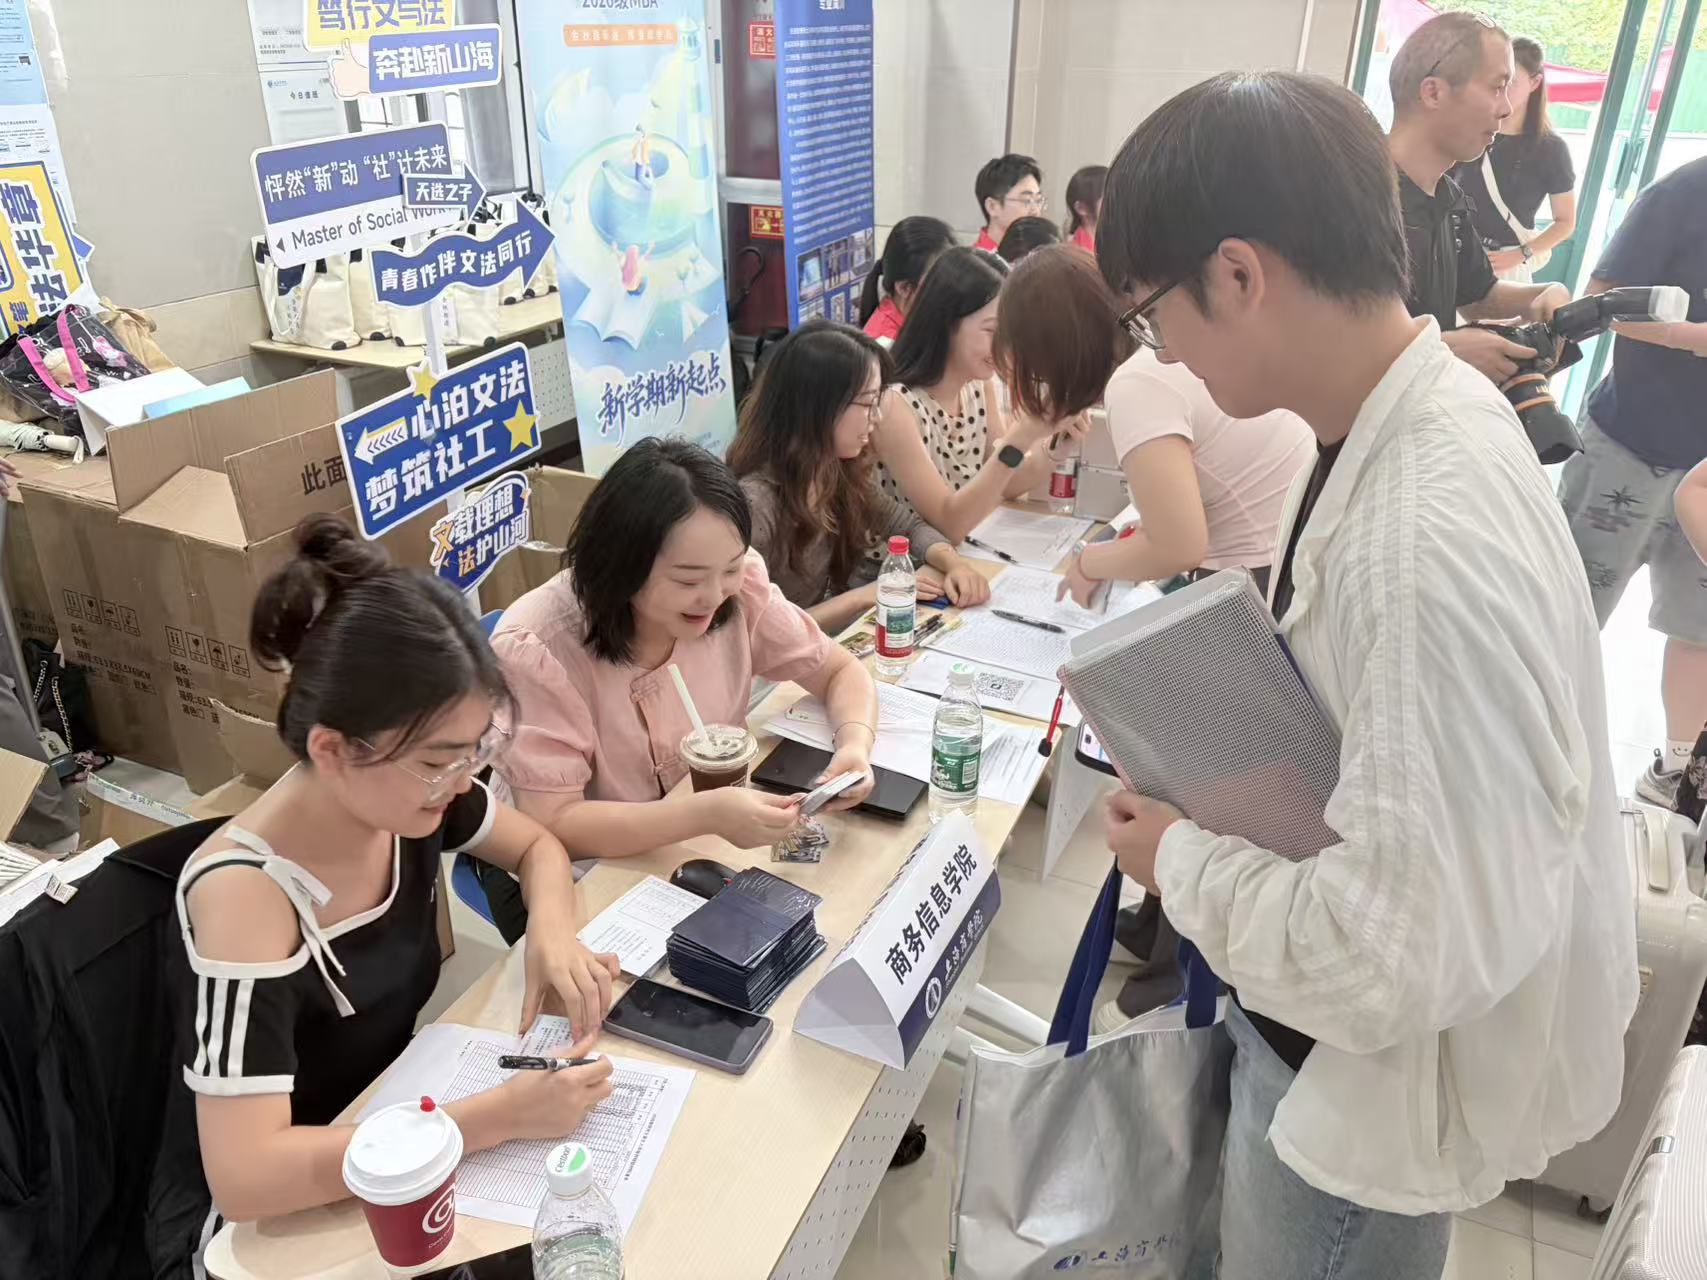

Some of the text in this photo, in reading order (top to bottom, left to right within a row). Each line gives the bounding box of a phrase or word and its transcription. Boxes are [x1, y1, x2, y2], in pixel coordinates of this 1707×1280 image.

[373, 41, 495, 80] 奔赴新山海
[416, 182, 473, 202] 天选之子
[292, 223, 343, 249] Master
[349, 215, 363, 236] of
[366, 206, 408, 231] Social
[381, 230, 533, 291] 青春作伴文法同行
[411, 359, 526, 440] 心泊文法
[597, 352, 727, 449] 新学期新起点
[301, 455, 348, 496] 此面
[365, 418, 496, 521] 梦筑社工
[458, 511, 528, 577] 法护山河
[884, 844, 978, 985] 商务信息学院
